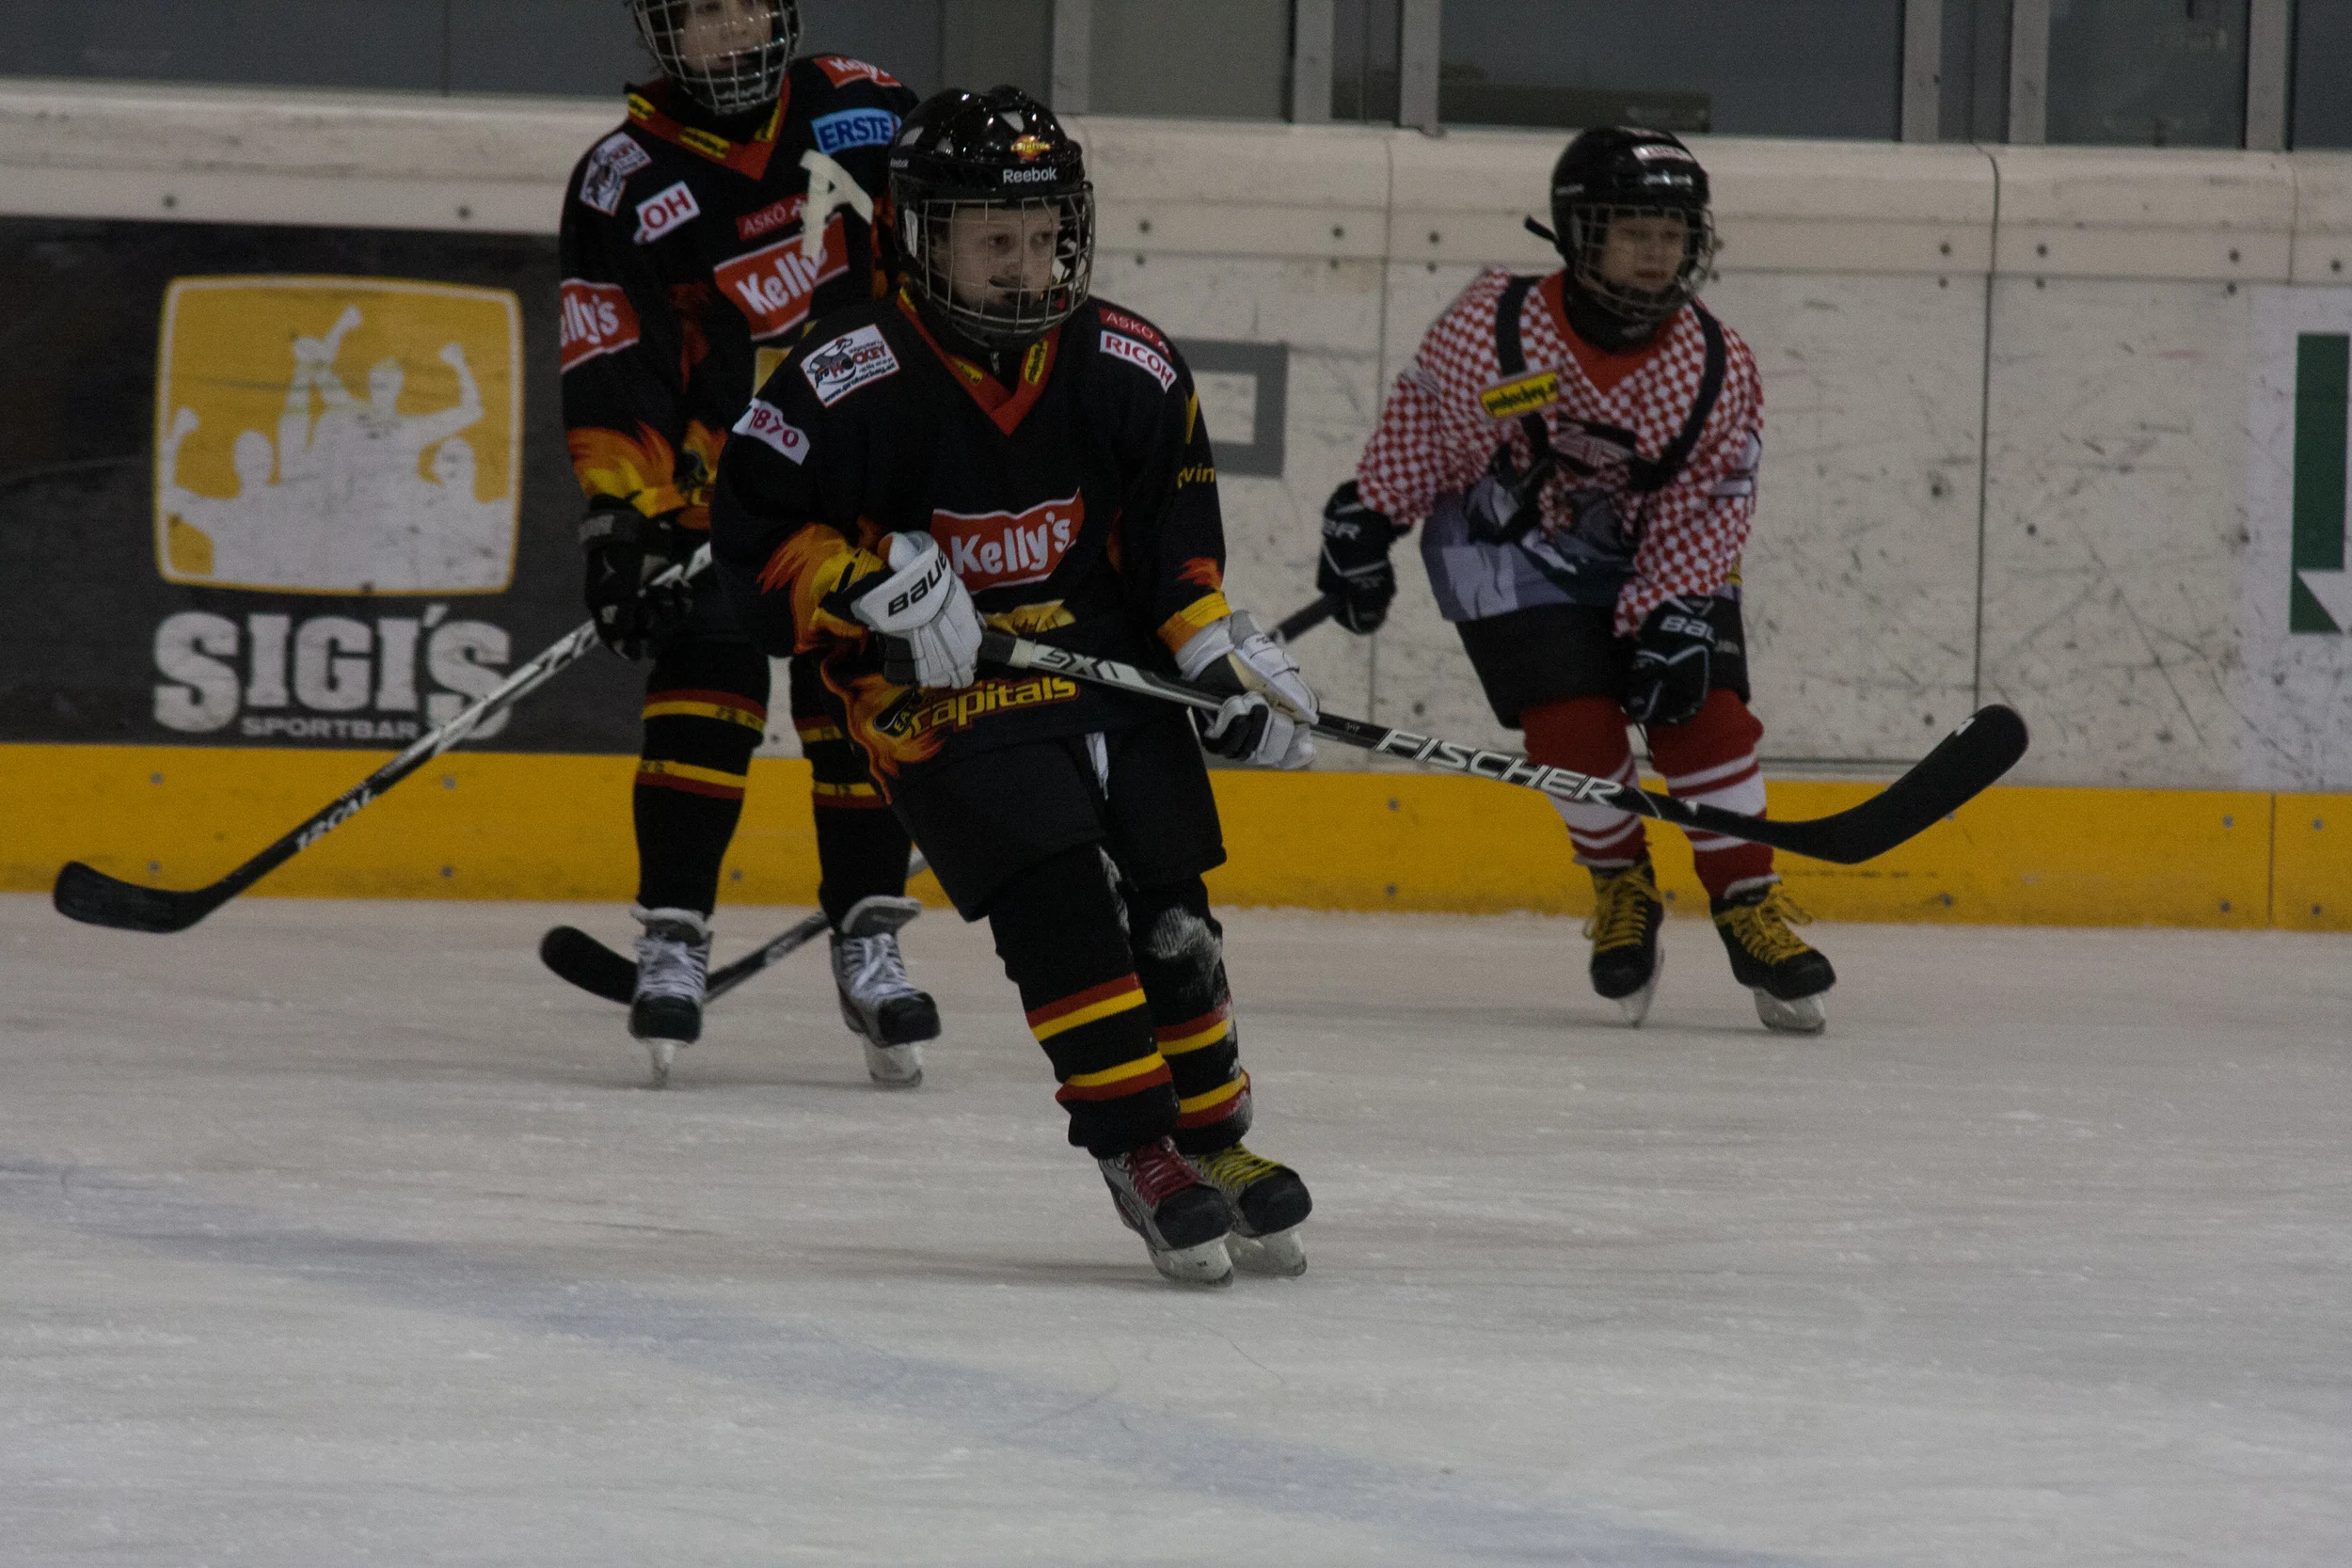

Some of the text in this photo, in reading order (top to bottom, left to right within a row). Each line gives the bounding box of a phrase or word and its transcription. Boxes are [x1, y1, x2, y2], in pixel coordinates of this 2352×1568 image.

[818, 117, 891, 150] ERSTE
[1002, 166, 1057, 183] Reebok
[1104, 334, 1175, 387] RICOH
[950, 512, 1072, 575] Kelly's
[152, 603, 512, 740] SIGI'S
[241, 716, 419, 739] SPORTBAR
[1375, 728, 1625, 805] FISCHER
